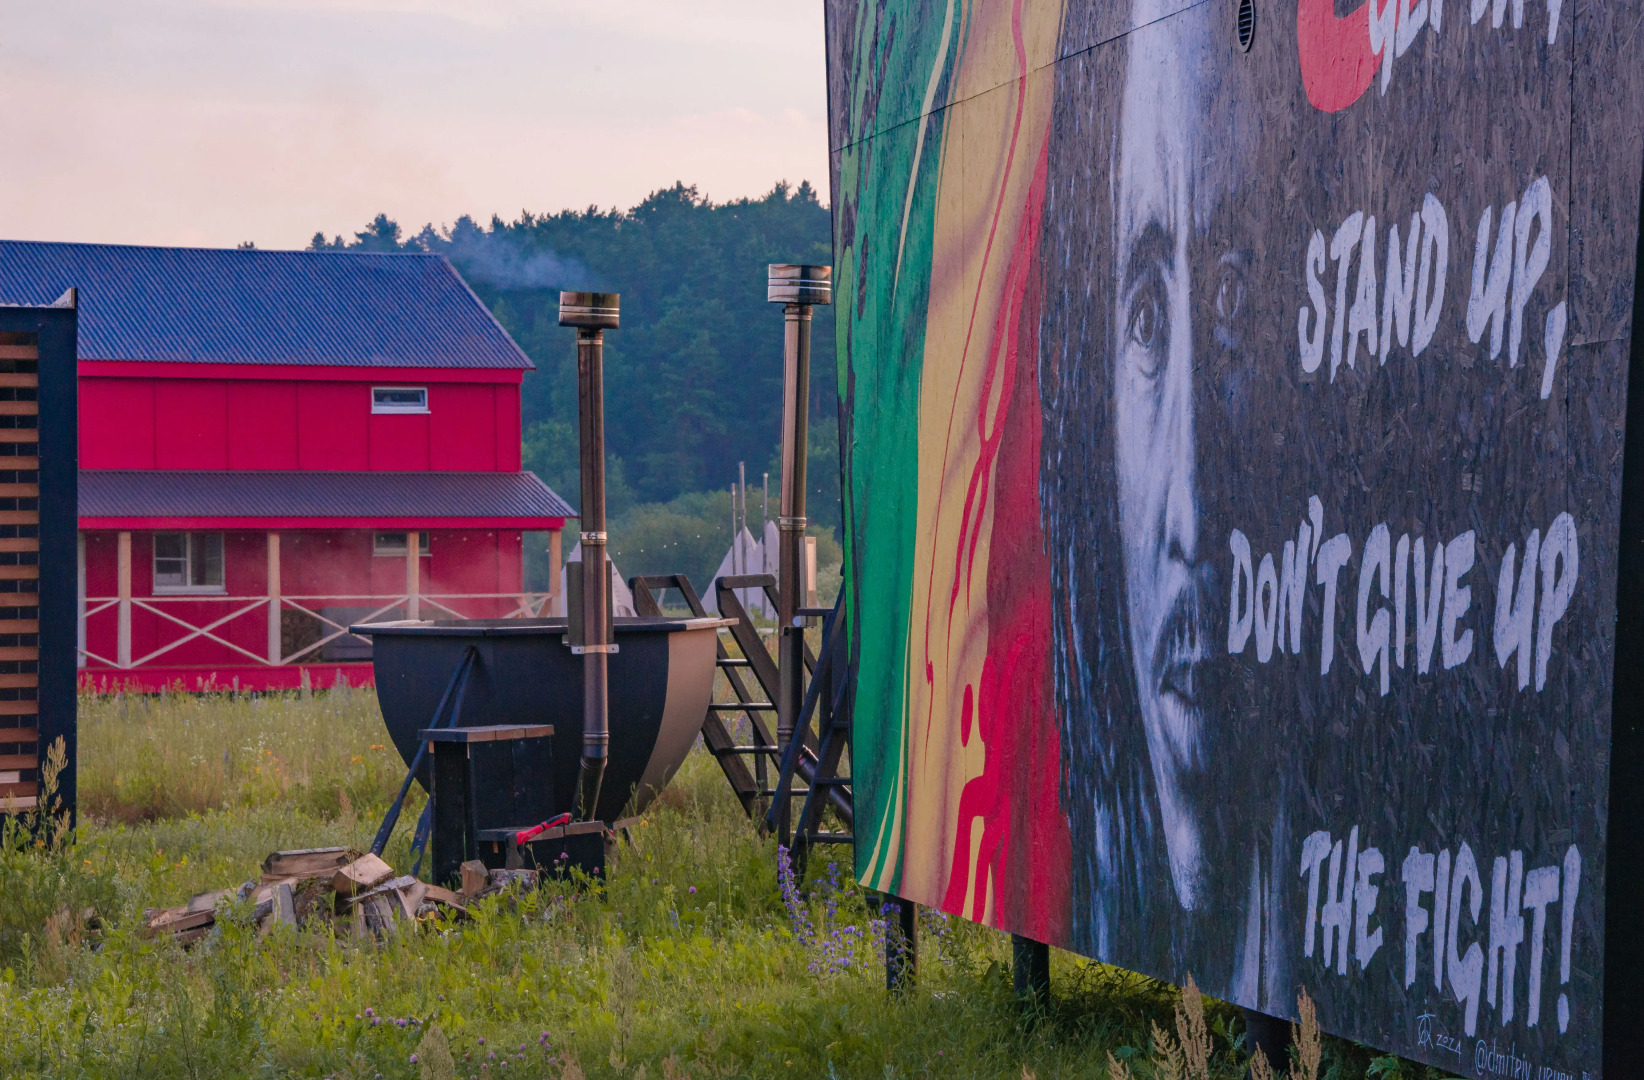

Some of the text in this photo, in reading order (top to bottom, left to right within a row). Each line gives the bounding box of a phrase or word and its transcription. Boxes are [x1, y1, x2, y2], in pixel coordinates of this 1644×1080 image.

[1298, 175, 1567, 399] STAND UP,
[1356, 522, 1476, 698] GIVE
[1493, 511, 1578, 693] UP
[1300, 825, 1581, 1038] THE FIGHT!
